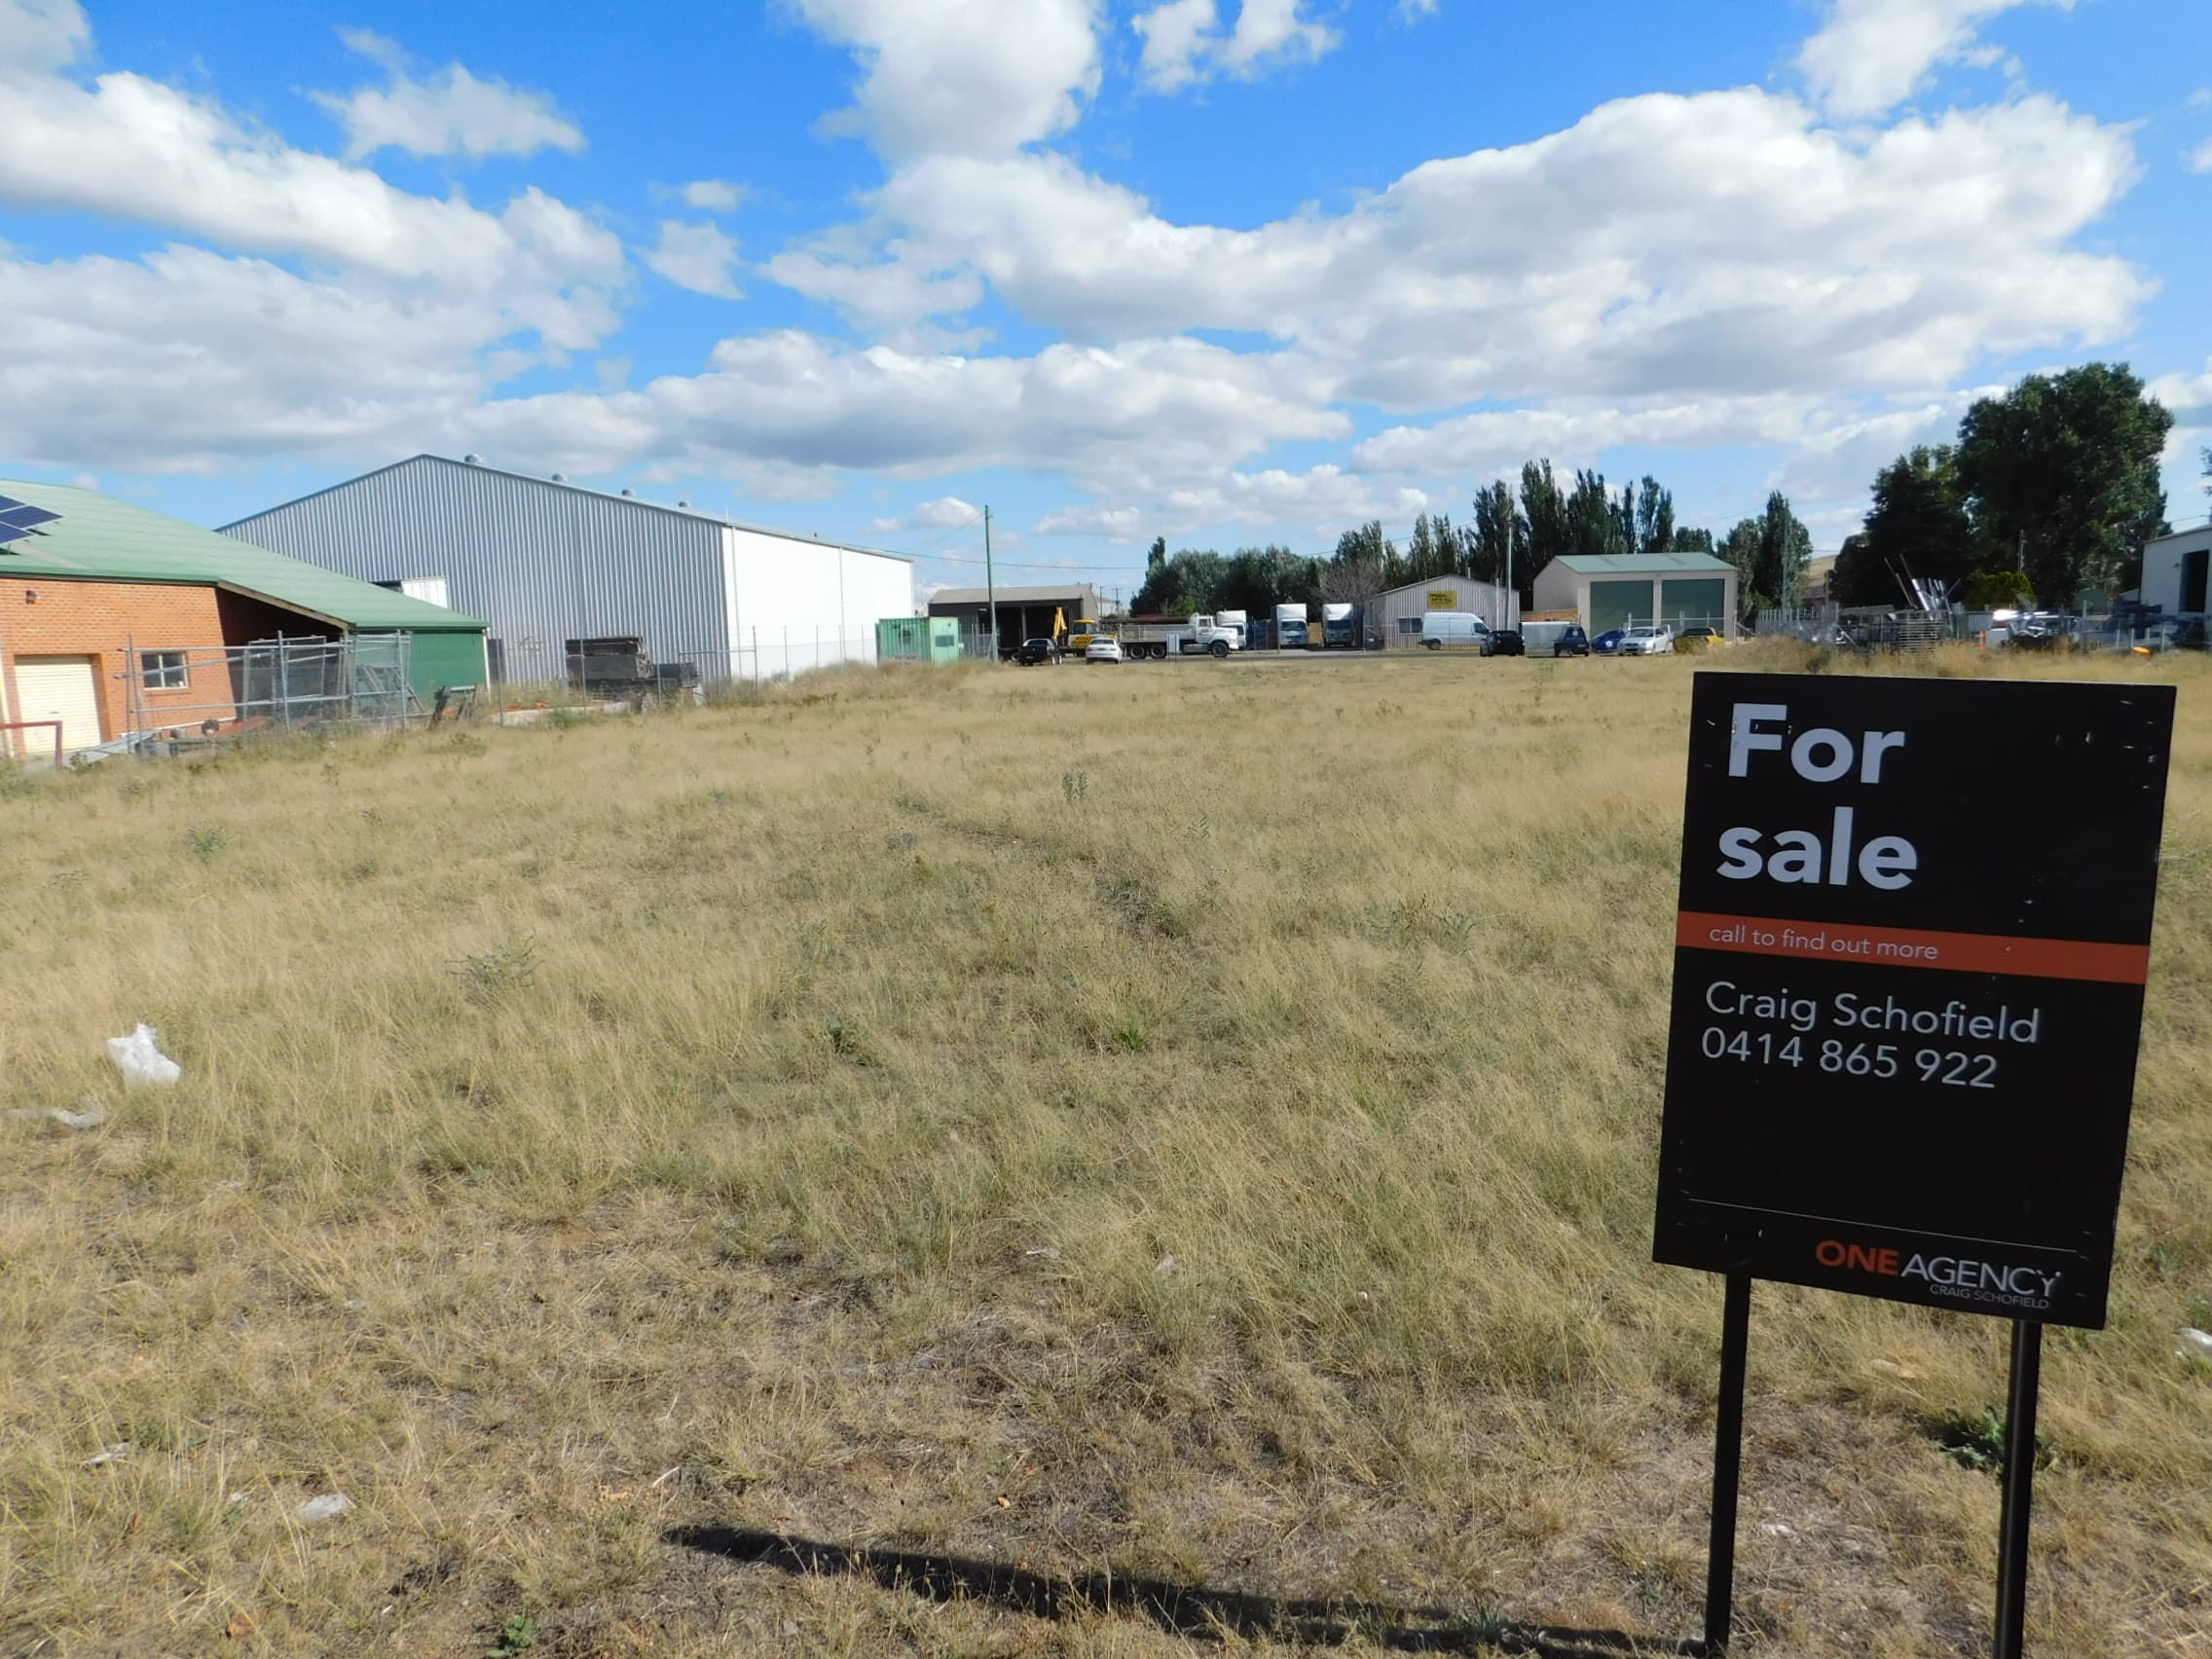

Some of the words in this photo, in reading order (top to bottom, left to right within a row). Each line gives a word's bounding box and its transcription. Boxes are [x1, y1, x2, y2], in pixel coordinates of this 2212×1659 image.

[1728, 702, 1905, 784] For
[1716, 807, 1918, 890] sale
[1709, 925, 1746, 943] call
[1752, 930, 1775, 945] to
[1782, 930, 1825, 951] find
[1831, 937, 1870, 955] out
[1876, 940, 1938, 960] more
[1705, 981, 1817, 1032] Craig
[1833, 993, 2040, 1043] Schofield
[1702, 1027, 1803, 1068] 0414
[1820, 1040, 1897, 1077] 865
[1915, 1050, 1997, 1088] 922
[1816, 1239, 1899, 1275] ONE
[1900, 1253, 2061, 1297] AGENCY
[1930, 1284, 1971, 1299] CRAIG
[1973, 1290, 2048, 1309] SCHOFIELD
